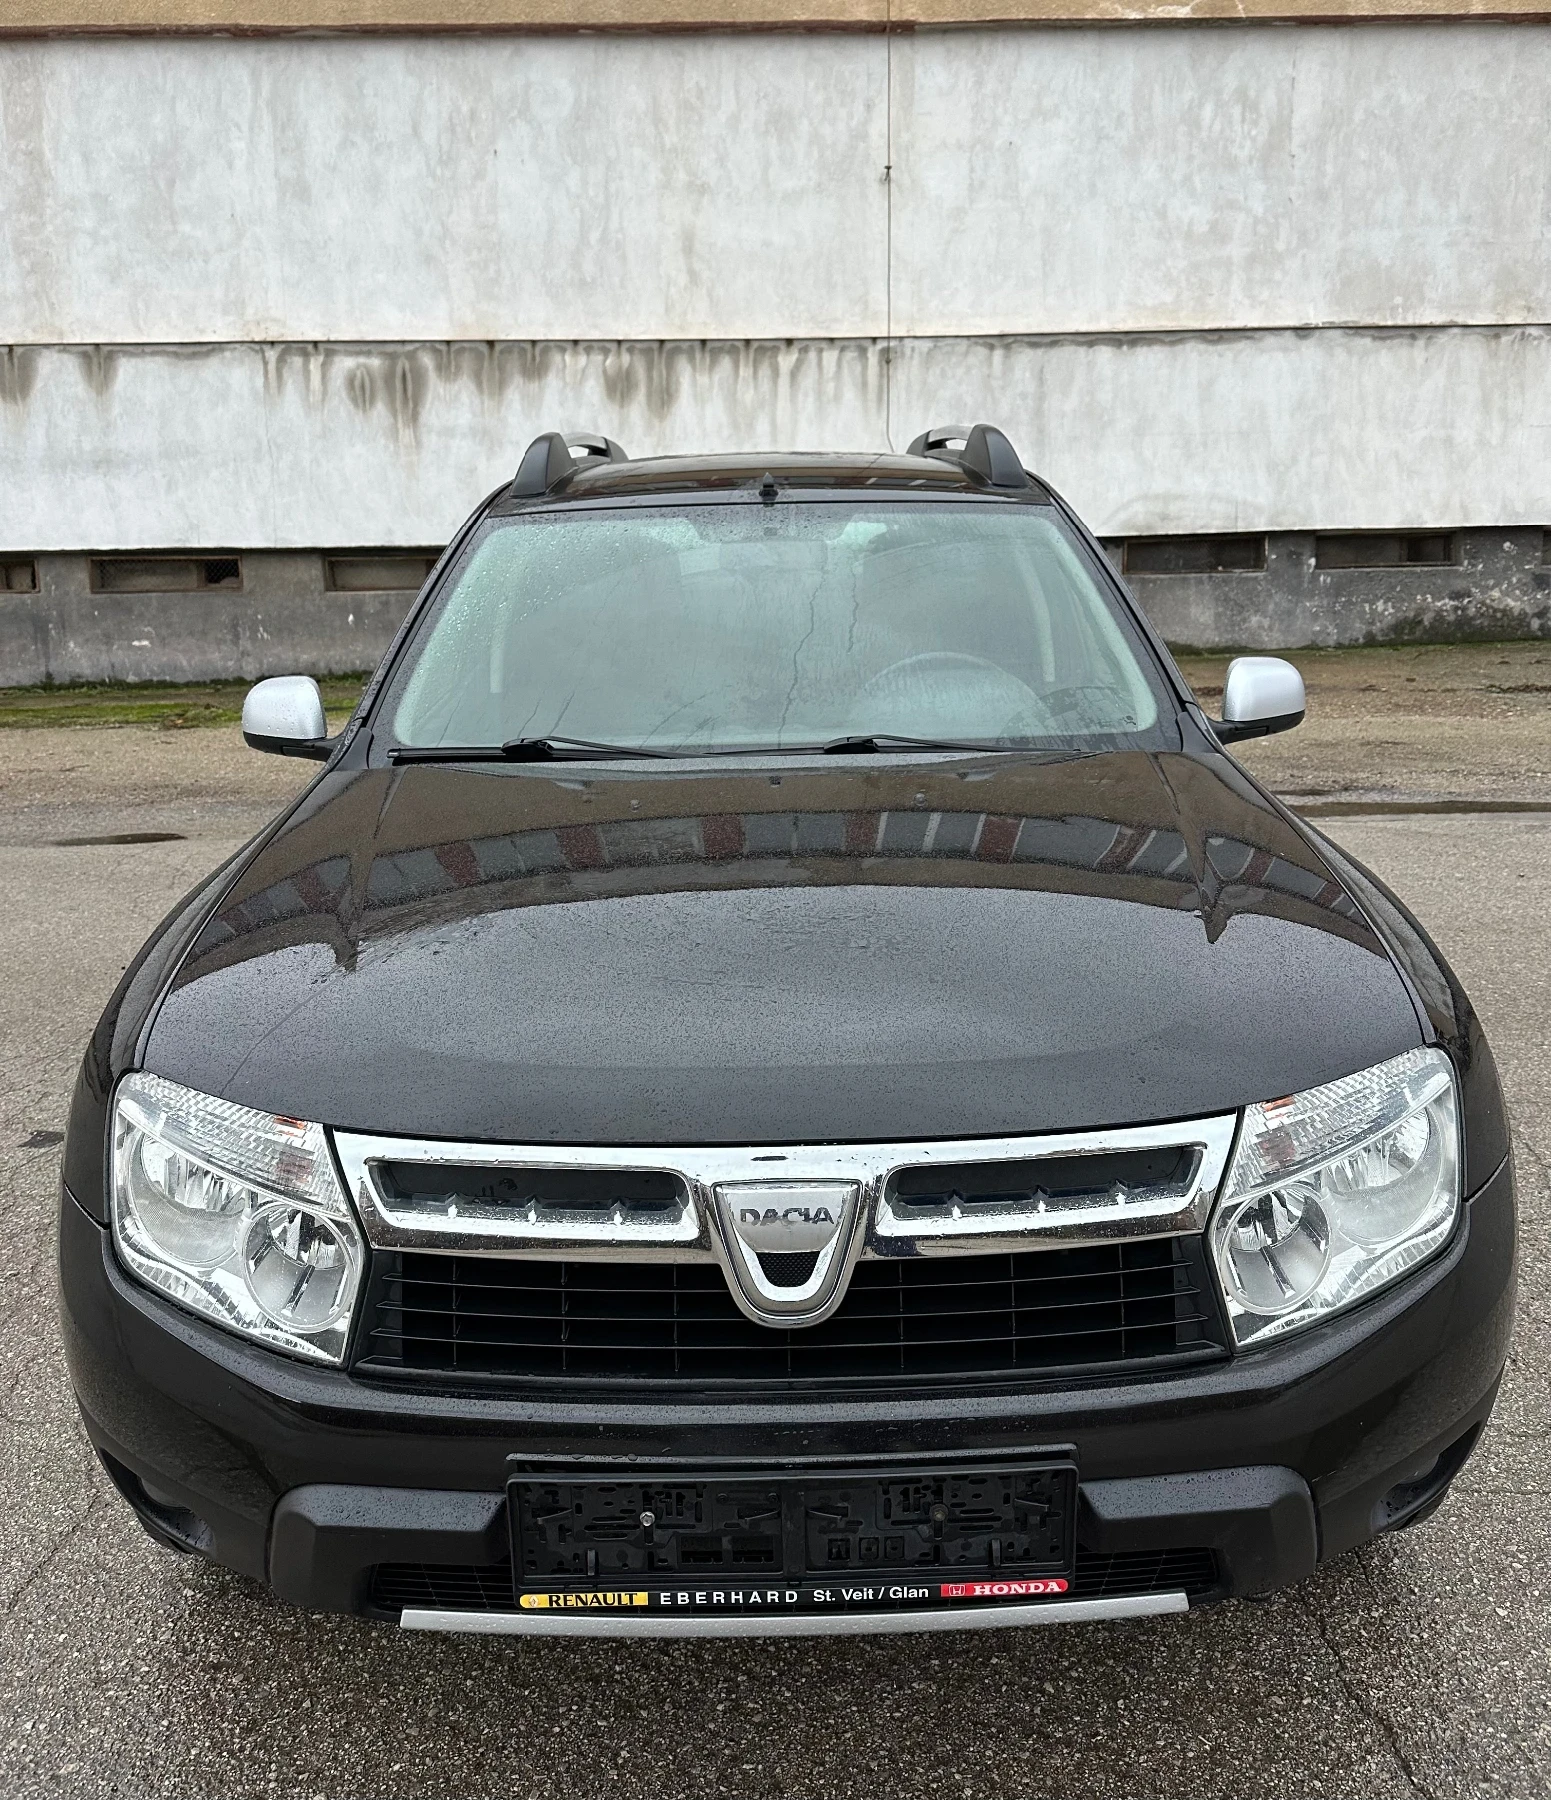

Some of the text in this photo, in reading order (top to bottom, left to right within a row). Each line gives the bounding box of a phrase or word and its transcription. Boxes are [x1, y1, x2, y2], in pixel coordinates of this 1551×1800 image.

[740, 1207, 834, 1226] DACIA
[547, 1582, 1062, 1607] RENAULT EBERHARD St. Veit / Glan HONDA
